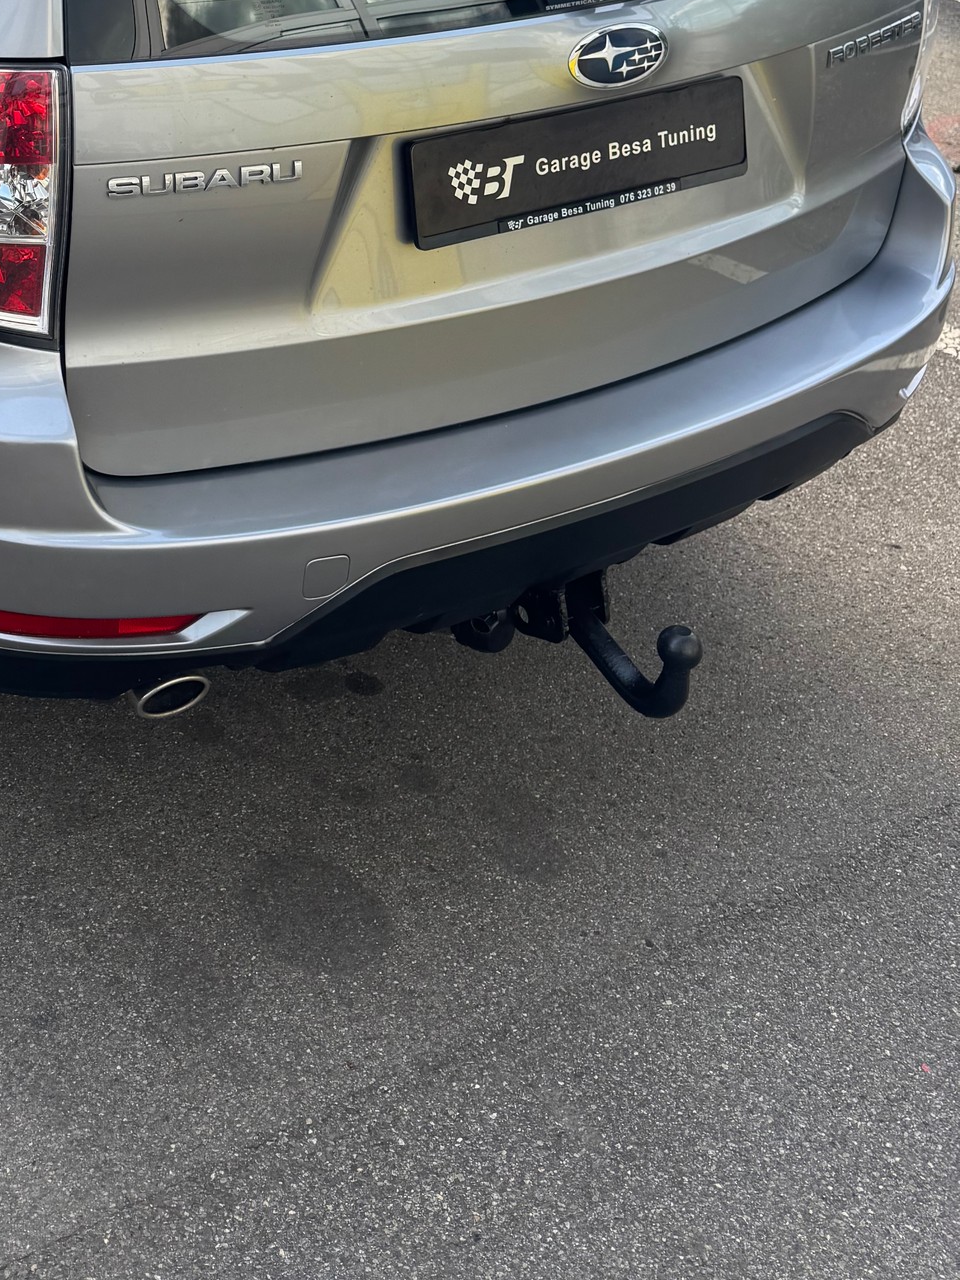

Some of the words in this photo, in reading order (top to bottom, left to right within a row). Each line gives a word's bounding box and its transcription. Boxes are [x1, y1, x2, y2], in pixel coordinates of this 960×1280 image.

[826, 11, 921, 68] FORESTER
[106, 160, 303, 198] SUBARU
[483, 154, 525, 200] BT
[535, 149, 601, 176] Garage
[608, 138, 652, 160] Besa
[657, 123, 717, 148] Tuning
[526, 211, 559, 226] Garage
[561, 206, 583, 217] Besa
[585, 198, 615, 212] Tuning
[619, 192, 635, 203] 076
[637, 188, 652, 200] 323
[654, 184, 664, 196] 02
[666, 182, 676, 193] 39
